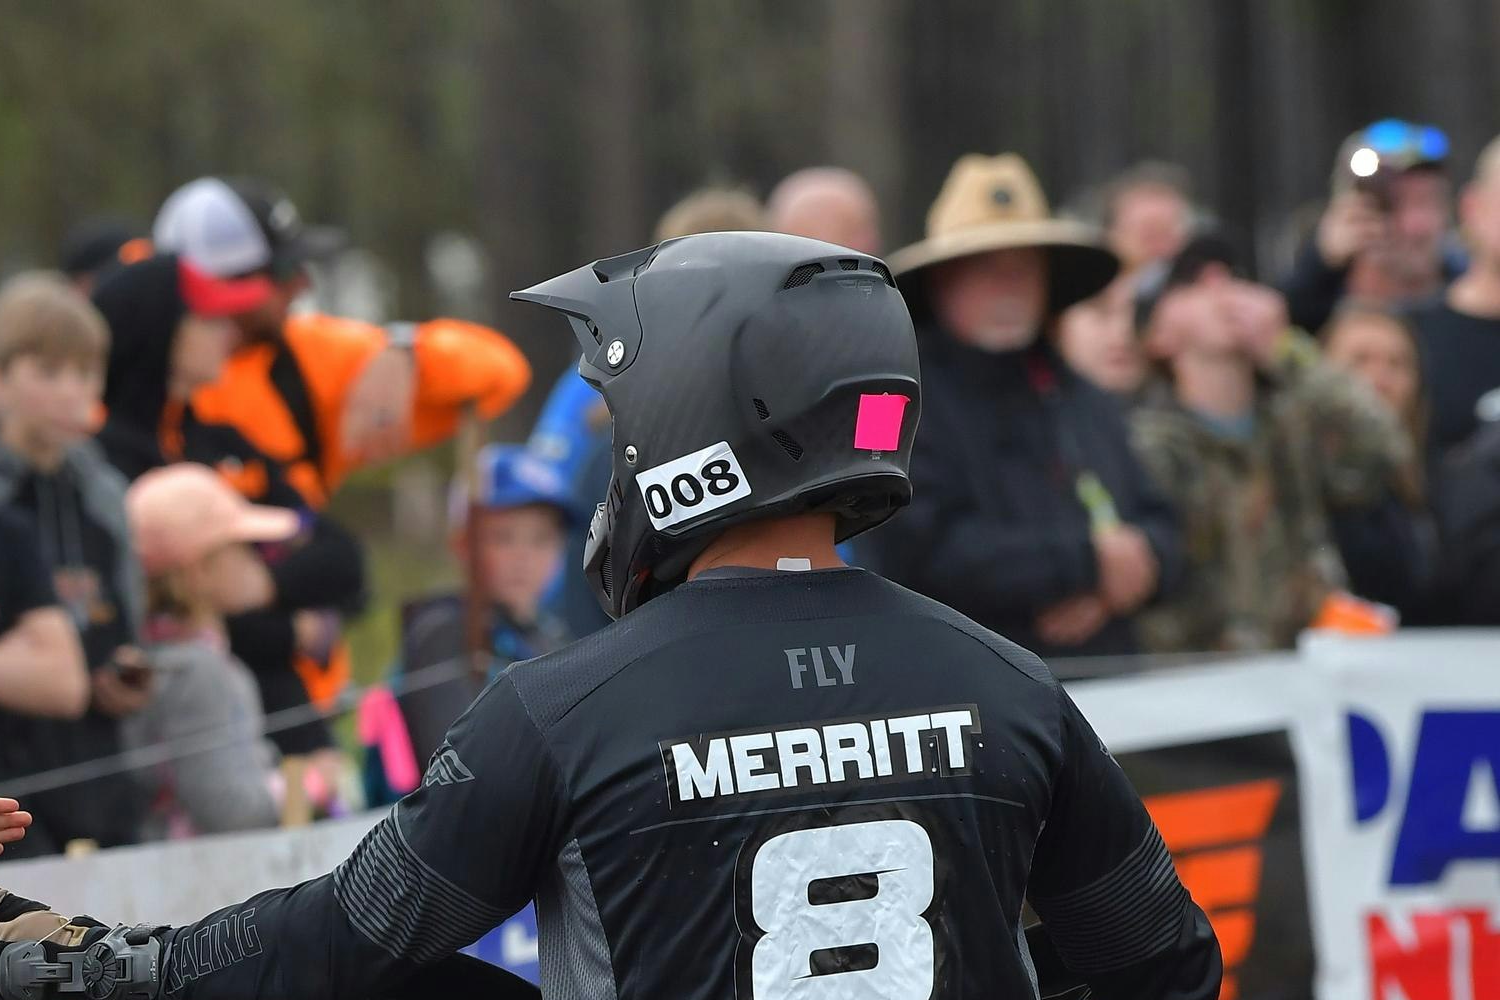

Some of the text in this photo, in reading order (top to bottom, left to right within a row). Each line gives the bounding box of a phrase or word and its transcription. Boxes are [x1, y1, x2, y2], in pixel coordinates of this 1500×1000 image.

[644, 459, 740, 519] 008
[783, 644, 857, 689] FLY
[670, 709, 972, 802] MERRITT
